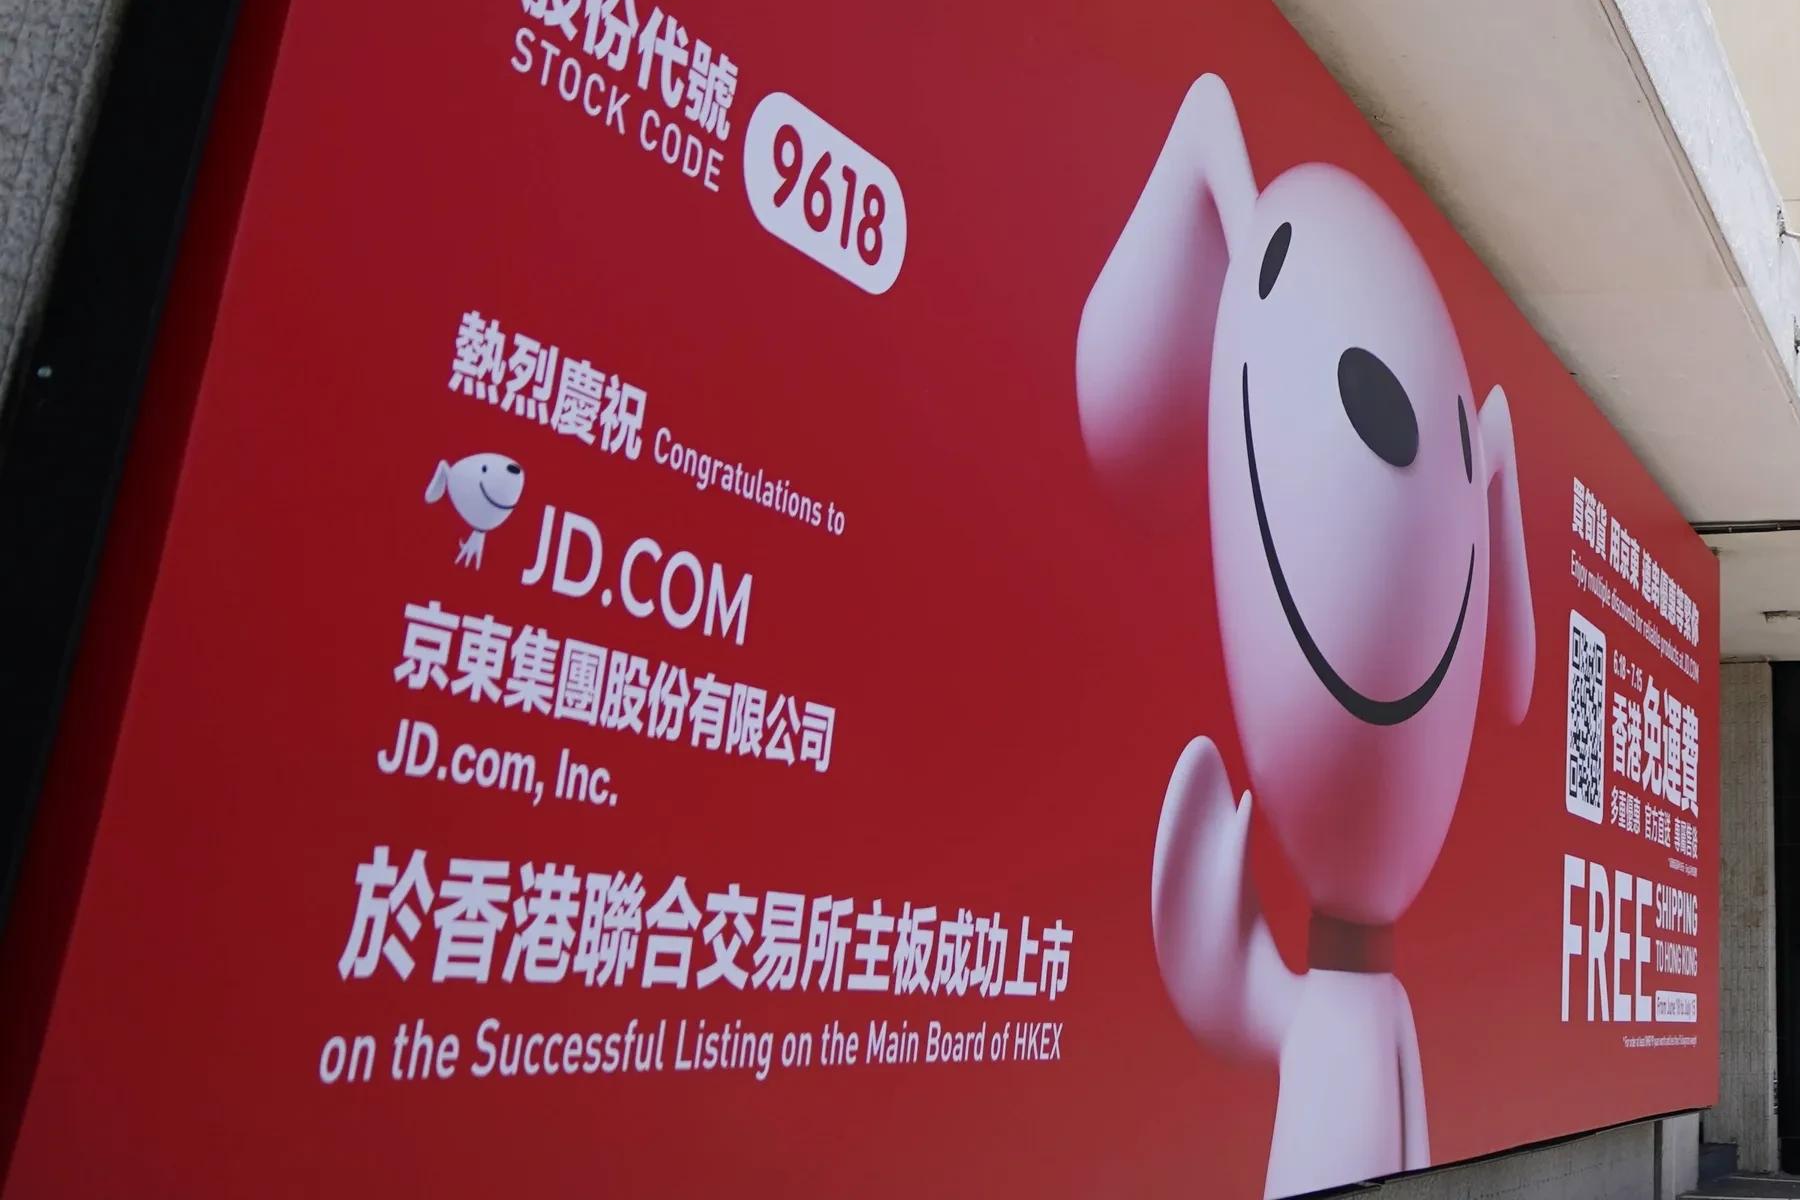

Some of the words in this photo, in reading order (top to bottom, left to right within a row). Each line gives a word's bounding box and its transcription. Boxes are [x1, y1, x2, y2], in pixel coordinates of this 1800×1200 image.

[511, 27, 631, 136] STOCK
[640, 108, 724, 192] CODE
[773, 124, 886, 266] 9618
[447, 310, 648, 461] 熱烈慶祝
[653, 426, 822, 527] Congratulations
[827, 501, 845, 536] to
[520, 505, 753, 646] JD.COM
[1609, 516, 1640, 591] 用京東
[393, 601, 836, 772] 京東集團股份有限公司
[376, 718, 544, 806] JD.com,
[555, 749, 618, 806] Inc.
[1611, 785, 1640, 834] 多重優惠
[1645, 802, 1671, 848] 官方直送
[338, 844, 1074, 1001] 於香港聯合交易所主板成功上市
[1561, 853, 1653, 1021] FREE
[1655, 883, 1697, 936] SHIPPING
[1655, 939, 1664, 973] TO
[1664, 942, 1681, 975] HONG
[1681, 945, 1697, 977] KONG
[319, 1032, 376, 1084] on
[390, 1019, 459, 1079] the
[471, 1017, 665, 1077] Successful
[675, 1021, 773, 1082] Listing
[782, 1031, 812, 1067] on
[820, 1021, 858, 1067] the
[865, 1021, 919, 1065] Main
[926, 1022, 984, 1064] Board
[990, 1022, 1010, 1062] of
[1013, 1022, 1064, 1063] HKEX
